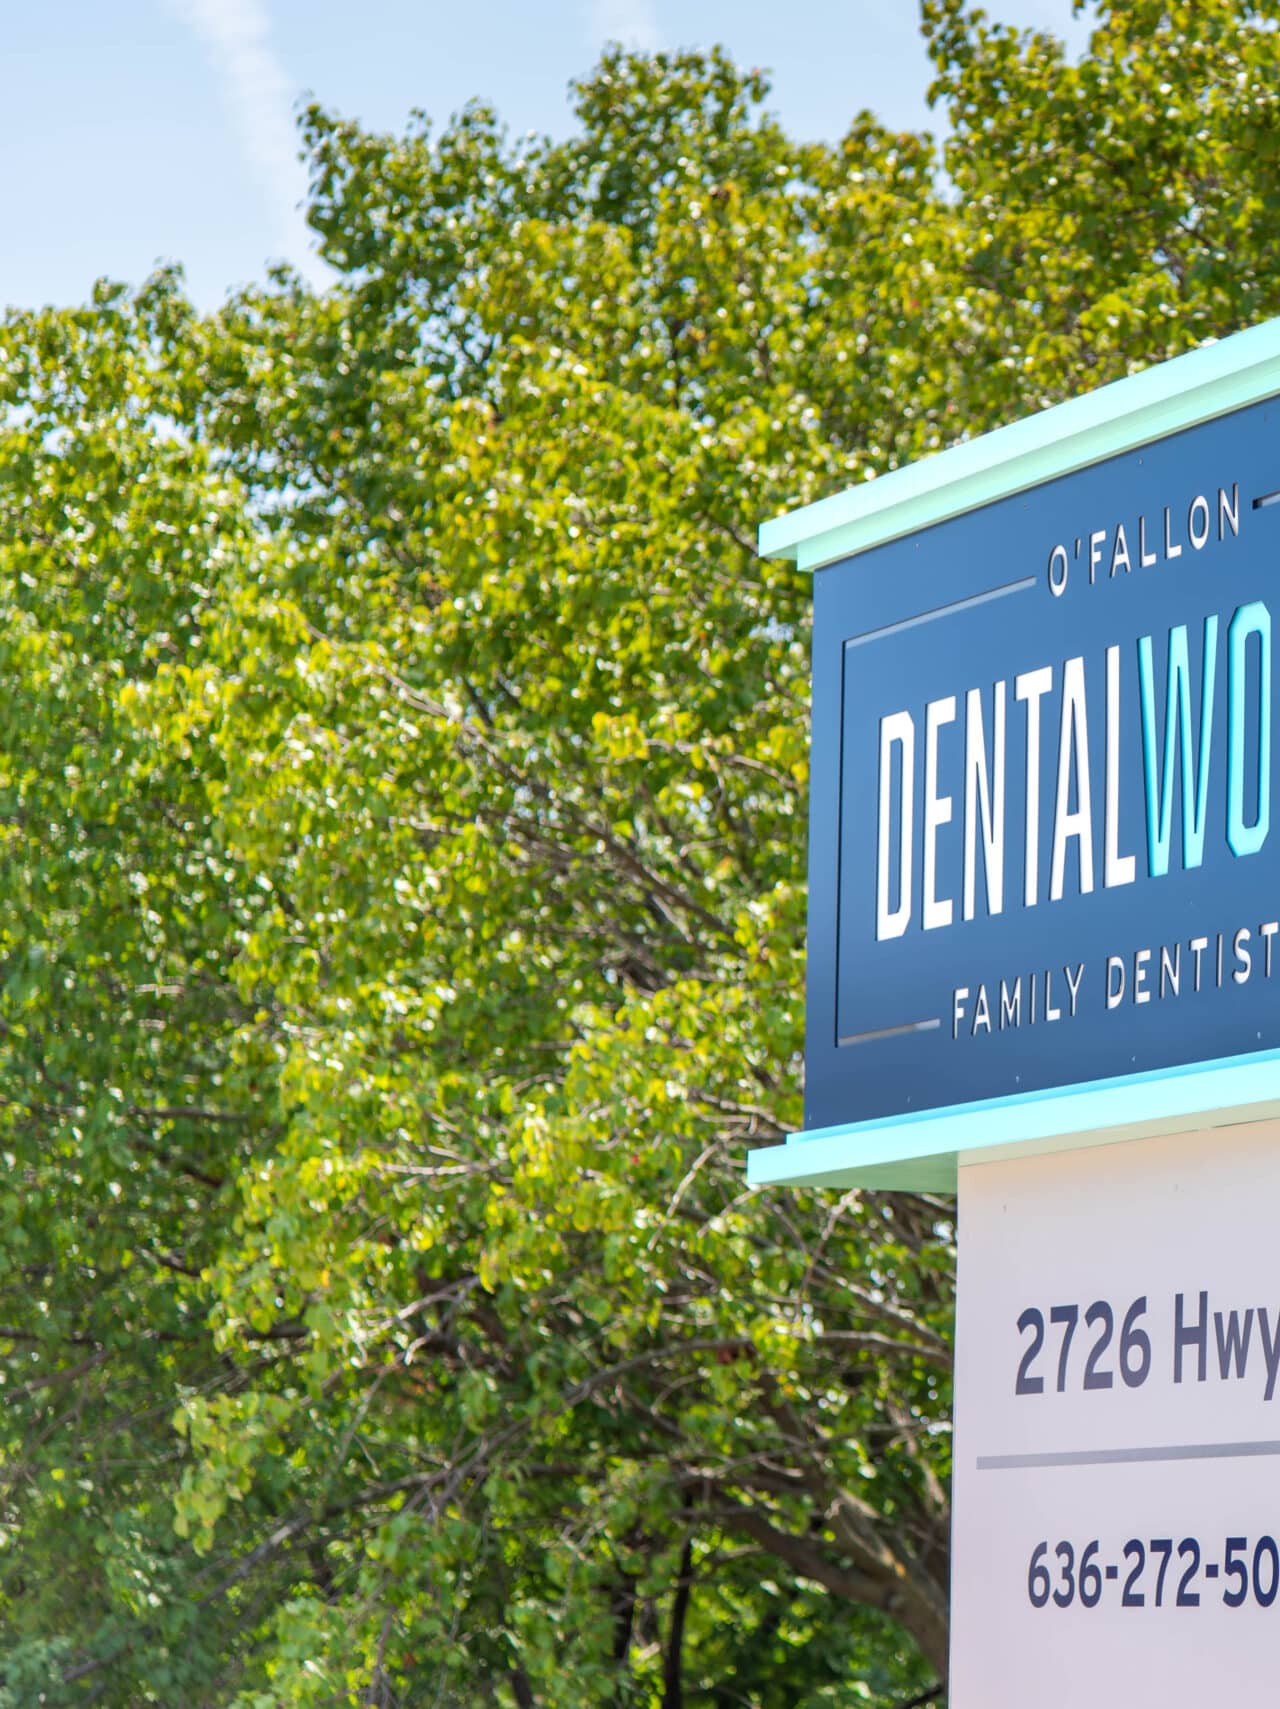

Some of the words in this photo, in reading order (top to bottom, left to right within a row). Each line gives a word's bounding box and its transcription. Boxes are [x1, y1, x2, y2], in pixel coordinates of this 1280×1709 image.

[1047, 482, 1240, 598] O'FALLON
[952, 962, 1085, 1040] FAMILY
[1014, 1295, 1152, 1396] 2726
